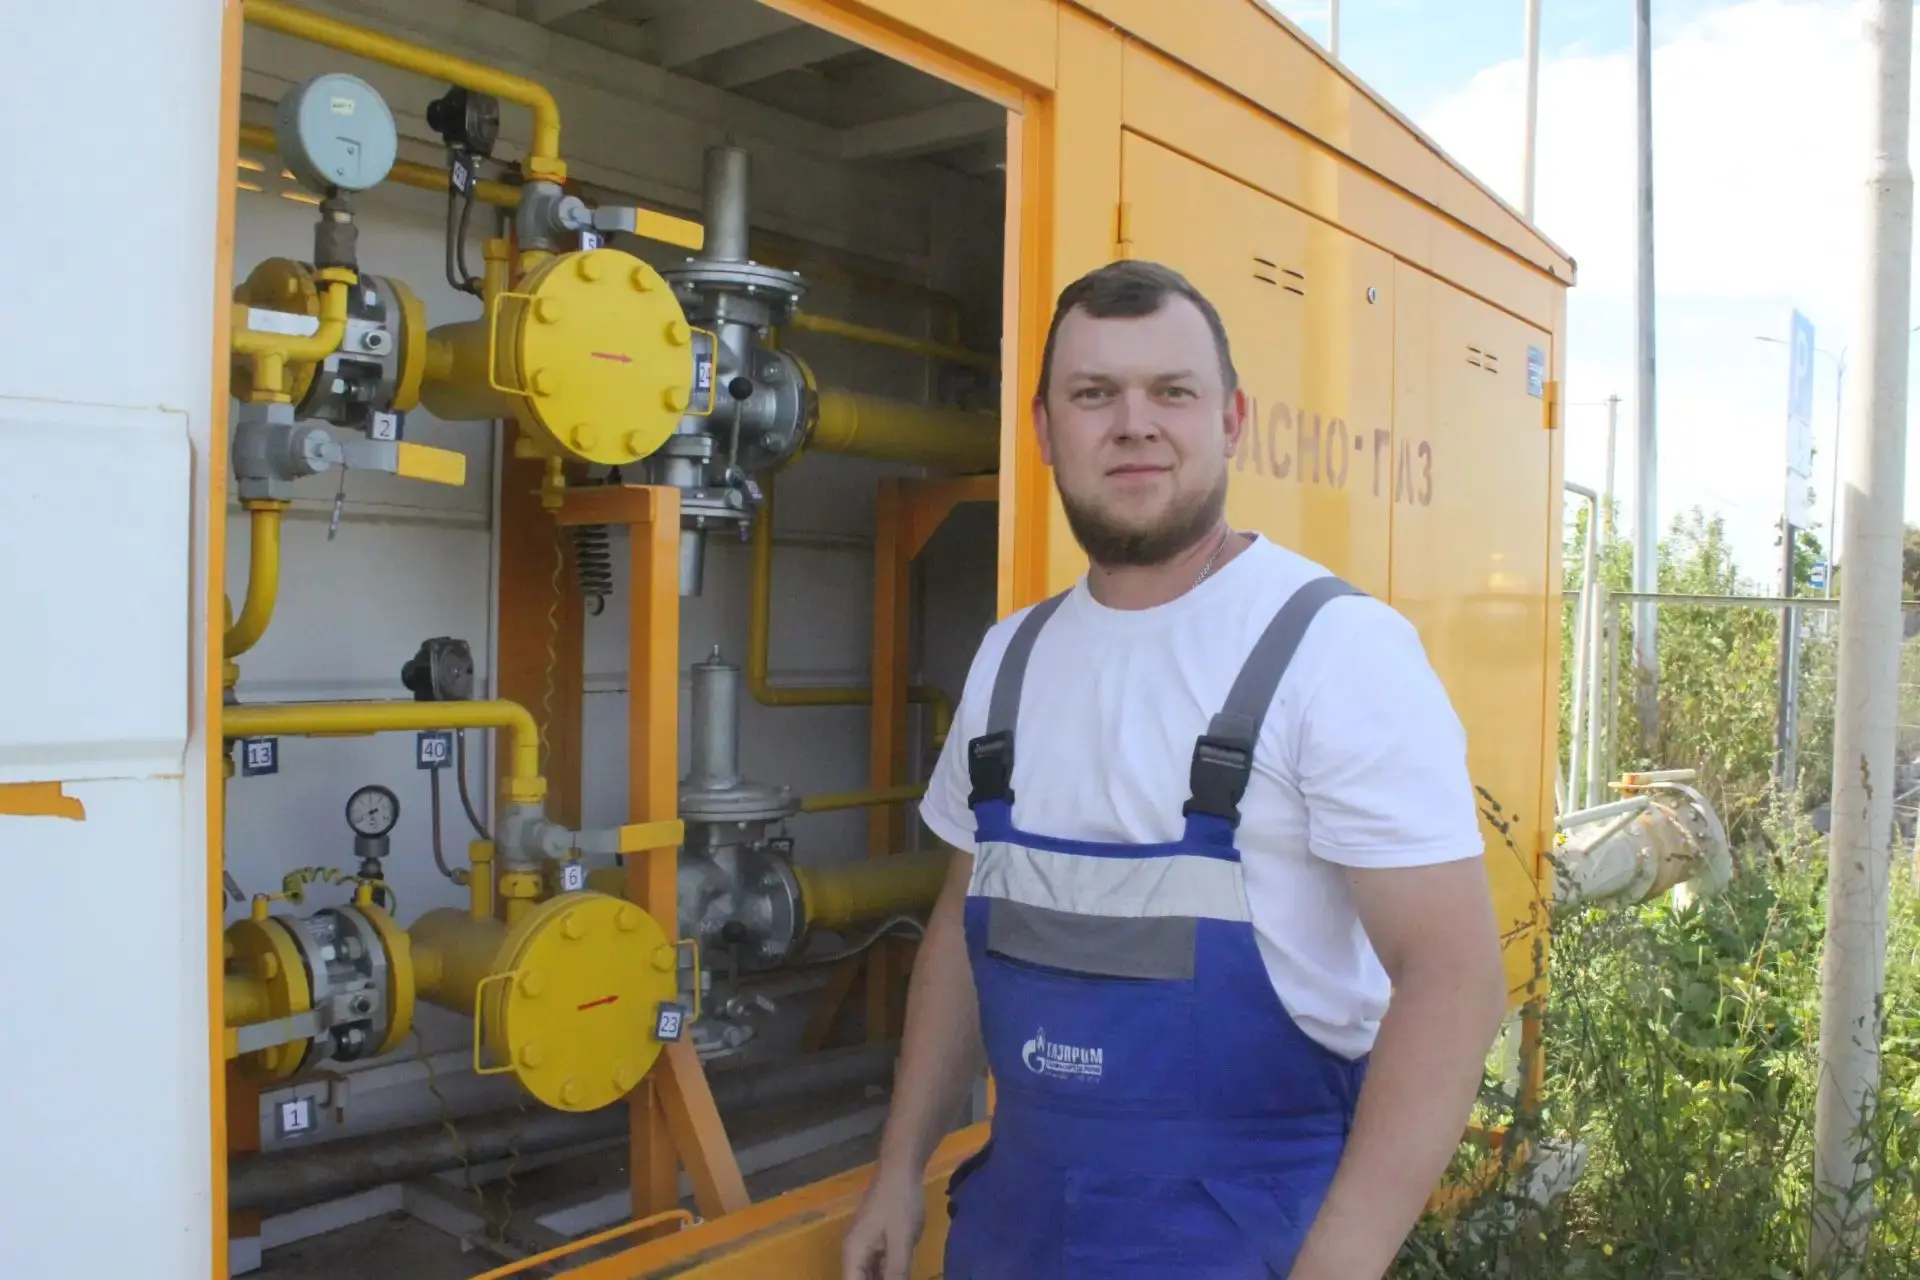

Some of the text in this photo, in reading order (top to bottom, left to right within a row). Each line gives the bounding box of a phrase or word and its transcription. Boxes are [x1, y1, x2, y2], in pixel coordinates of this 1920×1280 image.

[699, 366, 711, 382] 24
[380, 419, 390, 437] 2
[1236, 395, 1432, 507] АСНО-ГАЗ
[250, 747, 270, 764] 13
[424, 742, 445, 758] 40
[569, 868, 578, 886] 6
[661, 1015, 678, 1033] 23
[290, 1108, 301, 1127] 1
